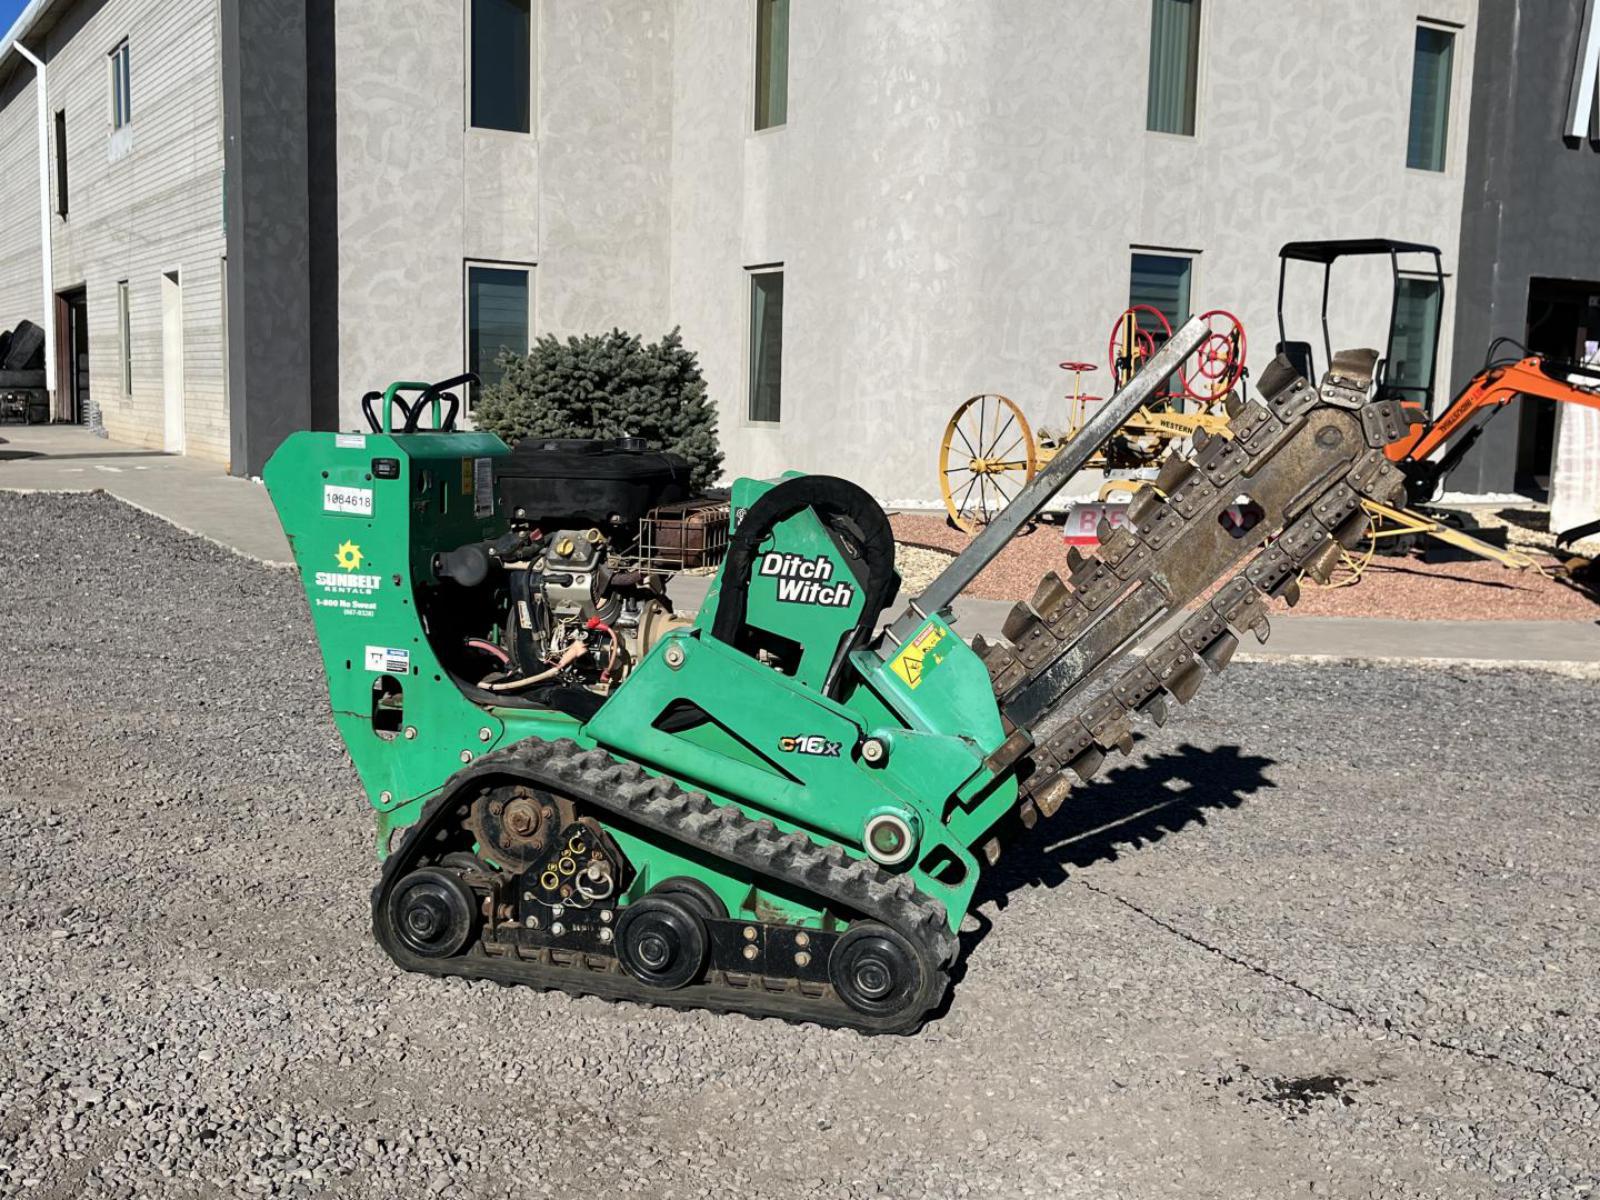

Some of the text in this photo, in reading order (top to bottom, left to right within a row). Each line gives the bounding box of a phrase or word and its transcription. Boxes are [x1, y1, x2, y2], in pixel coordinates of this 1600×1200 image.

[1160, 419, 1193, 434] WESTERN
[326, 493, 371, 508] 1084618
[760, 552, 833, 580] Ditch
[315, 571, 381, 590] SUNBELT
[324, 586, 372, 595] RENTALS
[778, 578, 852, 606] Witch
